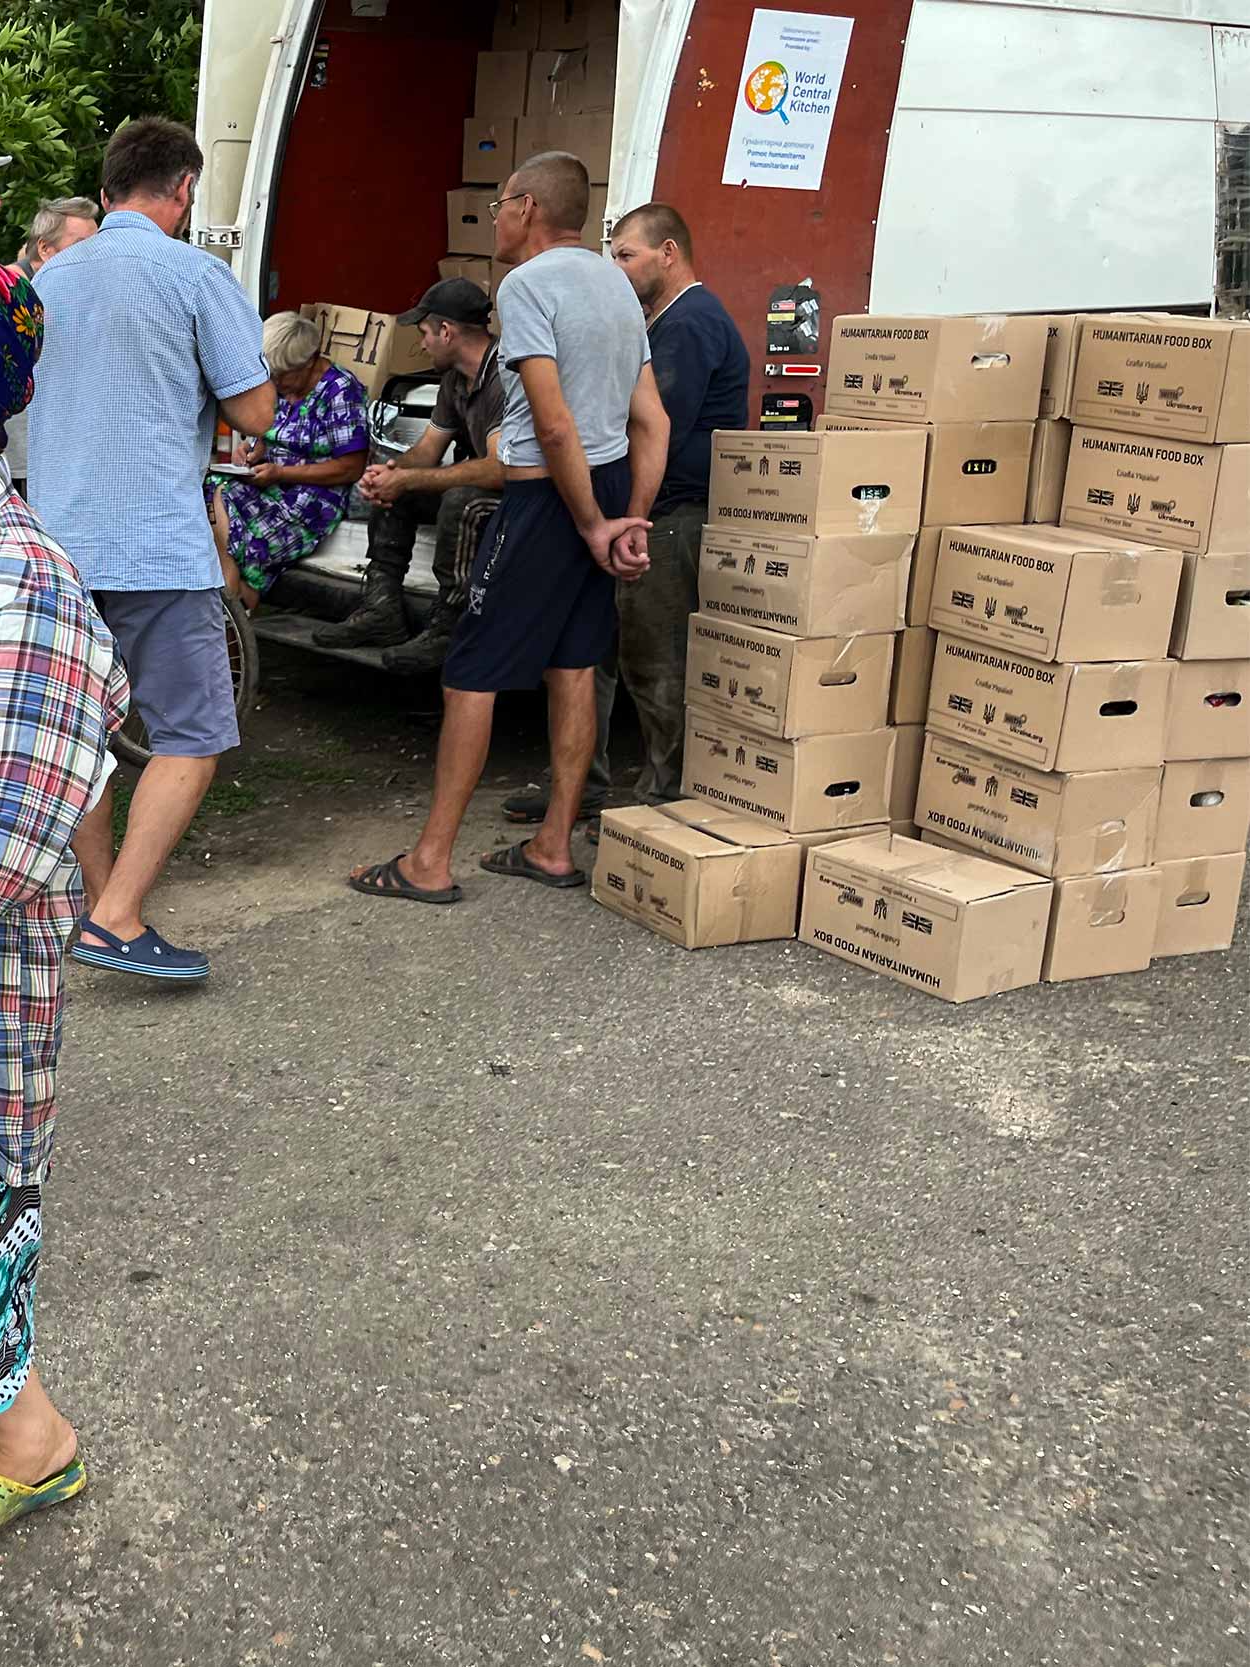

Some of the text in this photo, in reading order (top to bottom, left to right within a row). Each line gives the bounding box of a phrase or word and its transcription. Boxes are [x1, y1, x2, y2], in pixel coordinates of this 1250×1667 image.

[795, 71, 826, 85] World
[792, 85, 832, 100] Central
[790, 100, 830, 114] Kitchen
[747, 149, 806, 160] Pomoc humanitarna
[750, 161, 789, 170] Humanitarian
[840, 328, 930, 340] HUMANITARIAN FOOD BOX
[1092, 330, 1213, 350] HUMANITARIAN FOOD BOX
[1166, 401, 1203, 413] Ukraine.org
[1082, 438, 1205, 466] HUMANITARIAN FOOD BOX
[718, 506, 808, 524] HUMANITARIAN FOOD BOX
[1158, 512, 1195, 527] Ukraine.org
[950, 540, 1055, 574] HUMANITARIAN FOOD BOX
[706, 600, 798, 626] HUMANITARIAN FOOD BOX
[1010, 618, 1044, 634] Ukraine.org
[696, 626, 782, 658] HUMANITARIAN FOOD BOX
[945, 644, 1056, 685] HUMANITARIAN FOOD BOX
[1010, 726, 1044, 744] Ukraine.org
[692, 782, 785, 822] HUMANITARIAN FOOD BOX
[928, 810, 946, 825] BOX
[946, 818, 970, 834] FOOD
[602, 826, 650, 856] HUMANITARIAN
[650, 848, 670, 864] FOOD
[670, 856, 686, 872] BOX
[818, 874, 856, 896] Ukraine.org
[814, 928, 941, 988] HUMANITARIAN FOOD BOX
